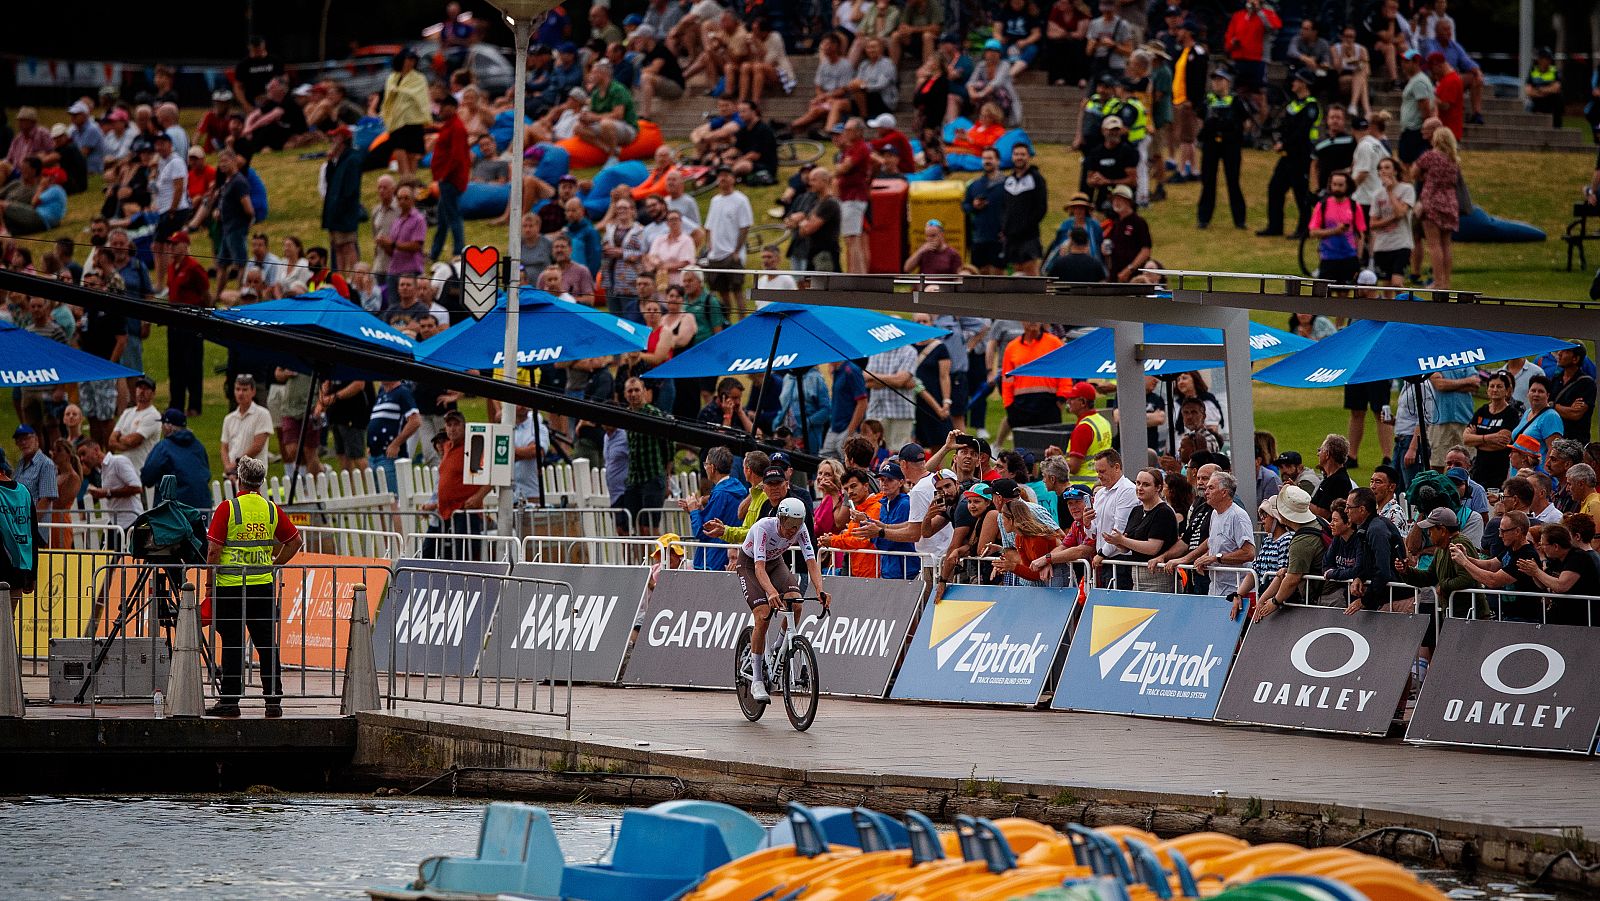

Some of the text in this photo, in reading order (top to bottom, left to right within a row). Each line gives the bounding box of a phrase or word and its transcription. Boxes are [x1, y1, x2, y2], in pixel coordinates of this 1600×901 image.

[360, 326, 413, 348] HAHN
[867, 323, 906, 343] HAHN
[1418, 348, 1486, 370] HAHN
[0, 368, 60, 384] HAHN
[1304, 368, 1347, 383] HAHN
[245, 511, 266, 520] SRS
[246, 523, 266, 532] SRS
[396, 588, 481, 647] HAHN
[511, 594, 618, 652] HAHN
[976, 676, 990, 684] TRACK
[1160, 689, 1177, 697] GUIDED
[1176, 690, 1191, 698] BLIND
[1190, 691, 1208, 699] SYSTEM
[1253, 681, 1375, 712] OAKLEY
[1443, 699, 1573, 729] OAKLEY
